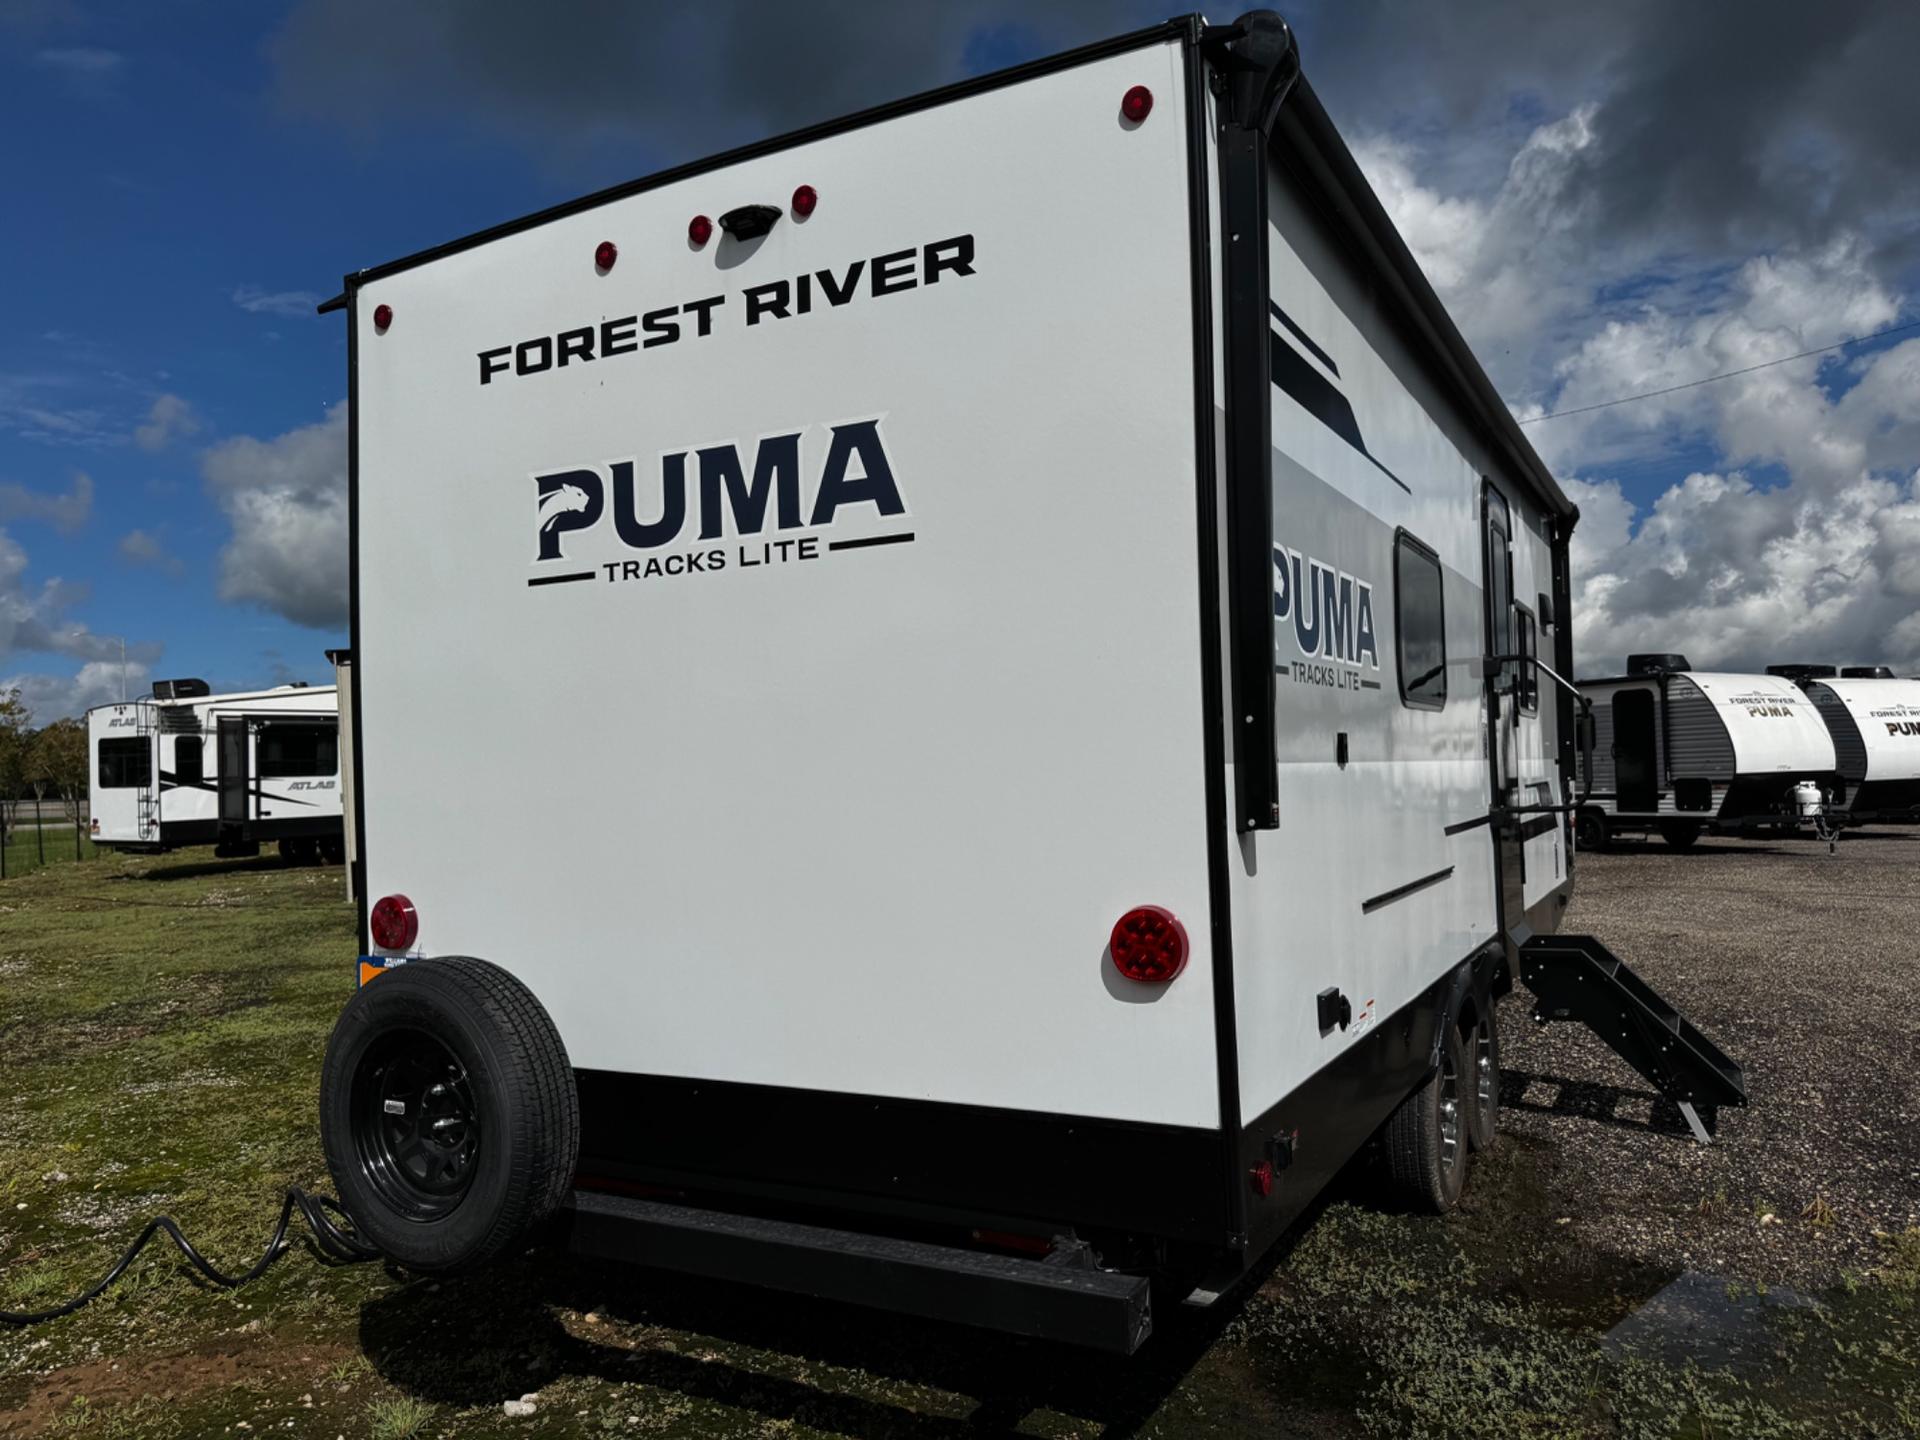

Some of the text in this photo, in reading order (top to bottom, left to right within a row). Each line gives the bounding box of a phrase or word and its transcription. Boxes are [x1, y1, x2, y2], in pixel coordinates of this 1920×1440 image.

[477, 233, 977, 386] FOREST RIVER
[531, 415, 908, 563] PUMA
[602, 537, 820, 583] TRACKS LITE
[1291, 660, 1360, 691] TRACKS LITE
[108, 717, 137, 728] ATLAS
[1746, 705, 1794, 718] PUMA
[287, 780, 336, 791] ATLAS
